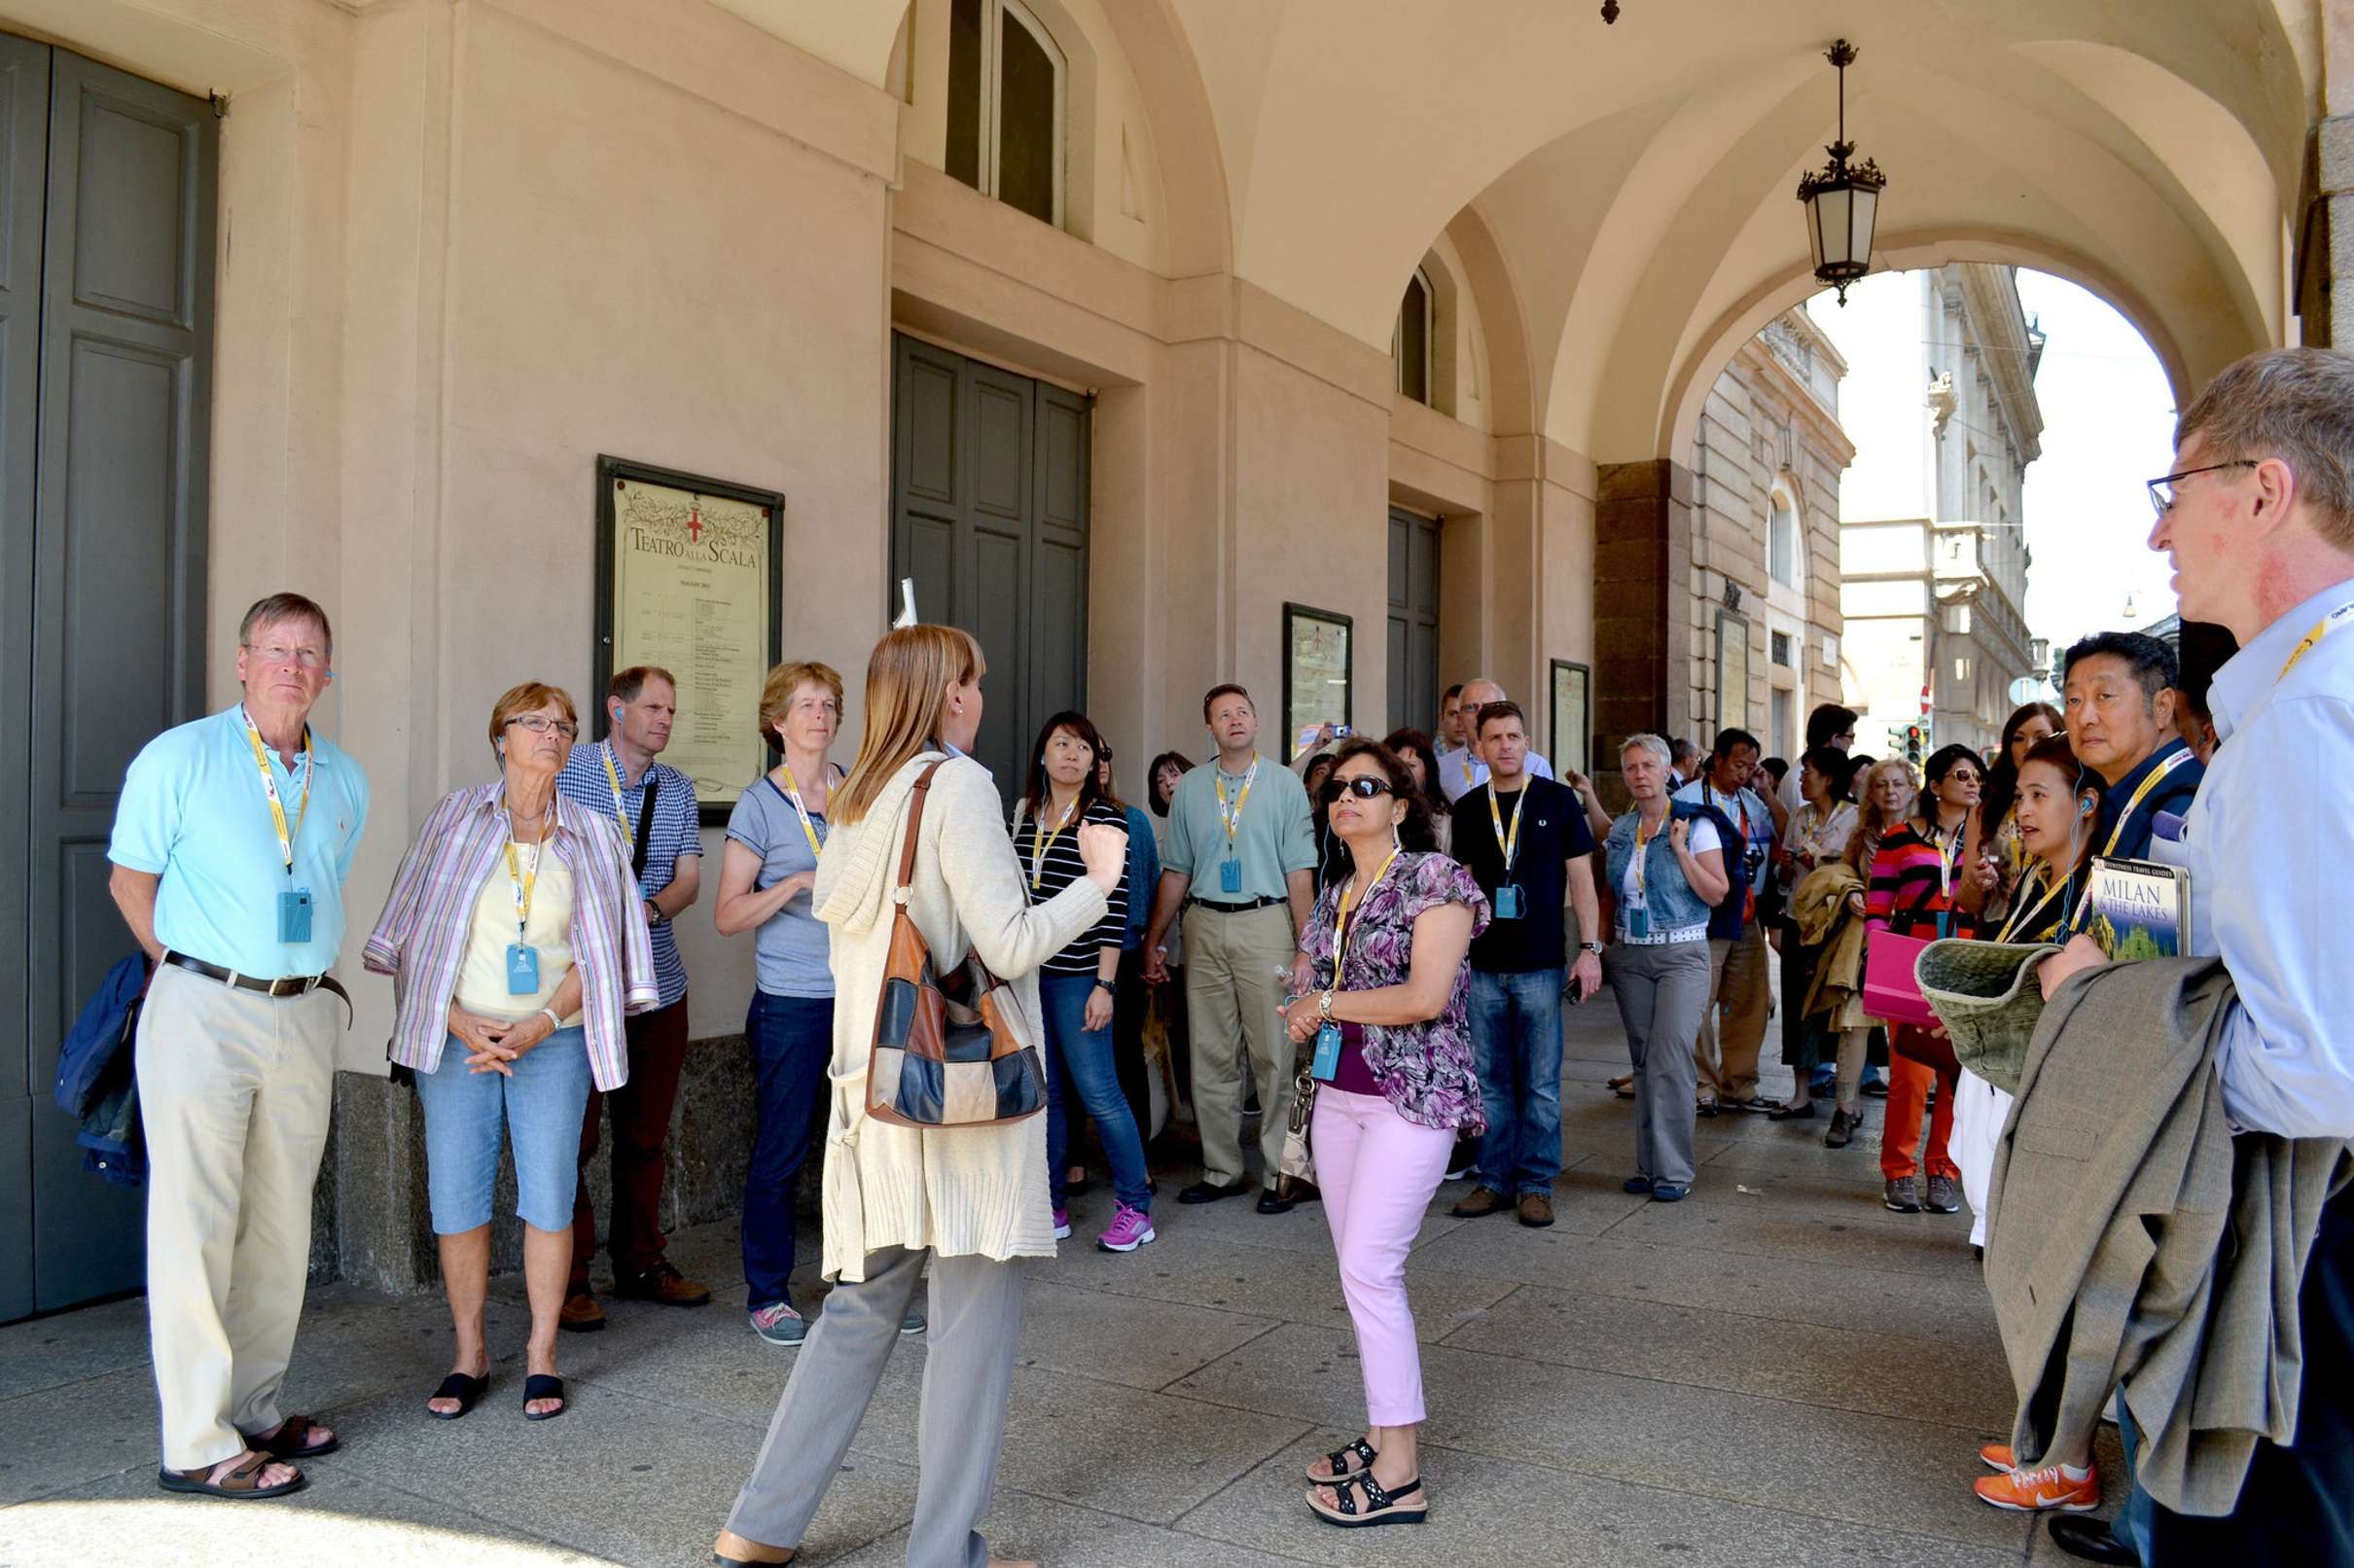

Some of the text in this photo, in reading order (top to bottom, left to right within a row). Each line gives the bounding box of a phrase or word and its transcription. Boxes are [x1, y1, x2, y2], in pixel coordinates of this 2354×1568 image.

[630, 526, 757, 569] TEATRO ALLA SCALA
[2133, 865, 2151, 874] TRAVEL
[2152, 868, 2172, 877] GUIDES
[2103, 879, 2160, 905] MILAN
[2099, 899, 2168, 919] & THE LAKES
